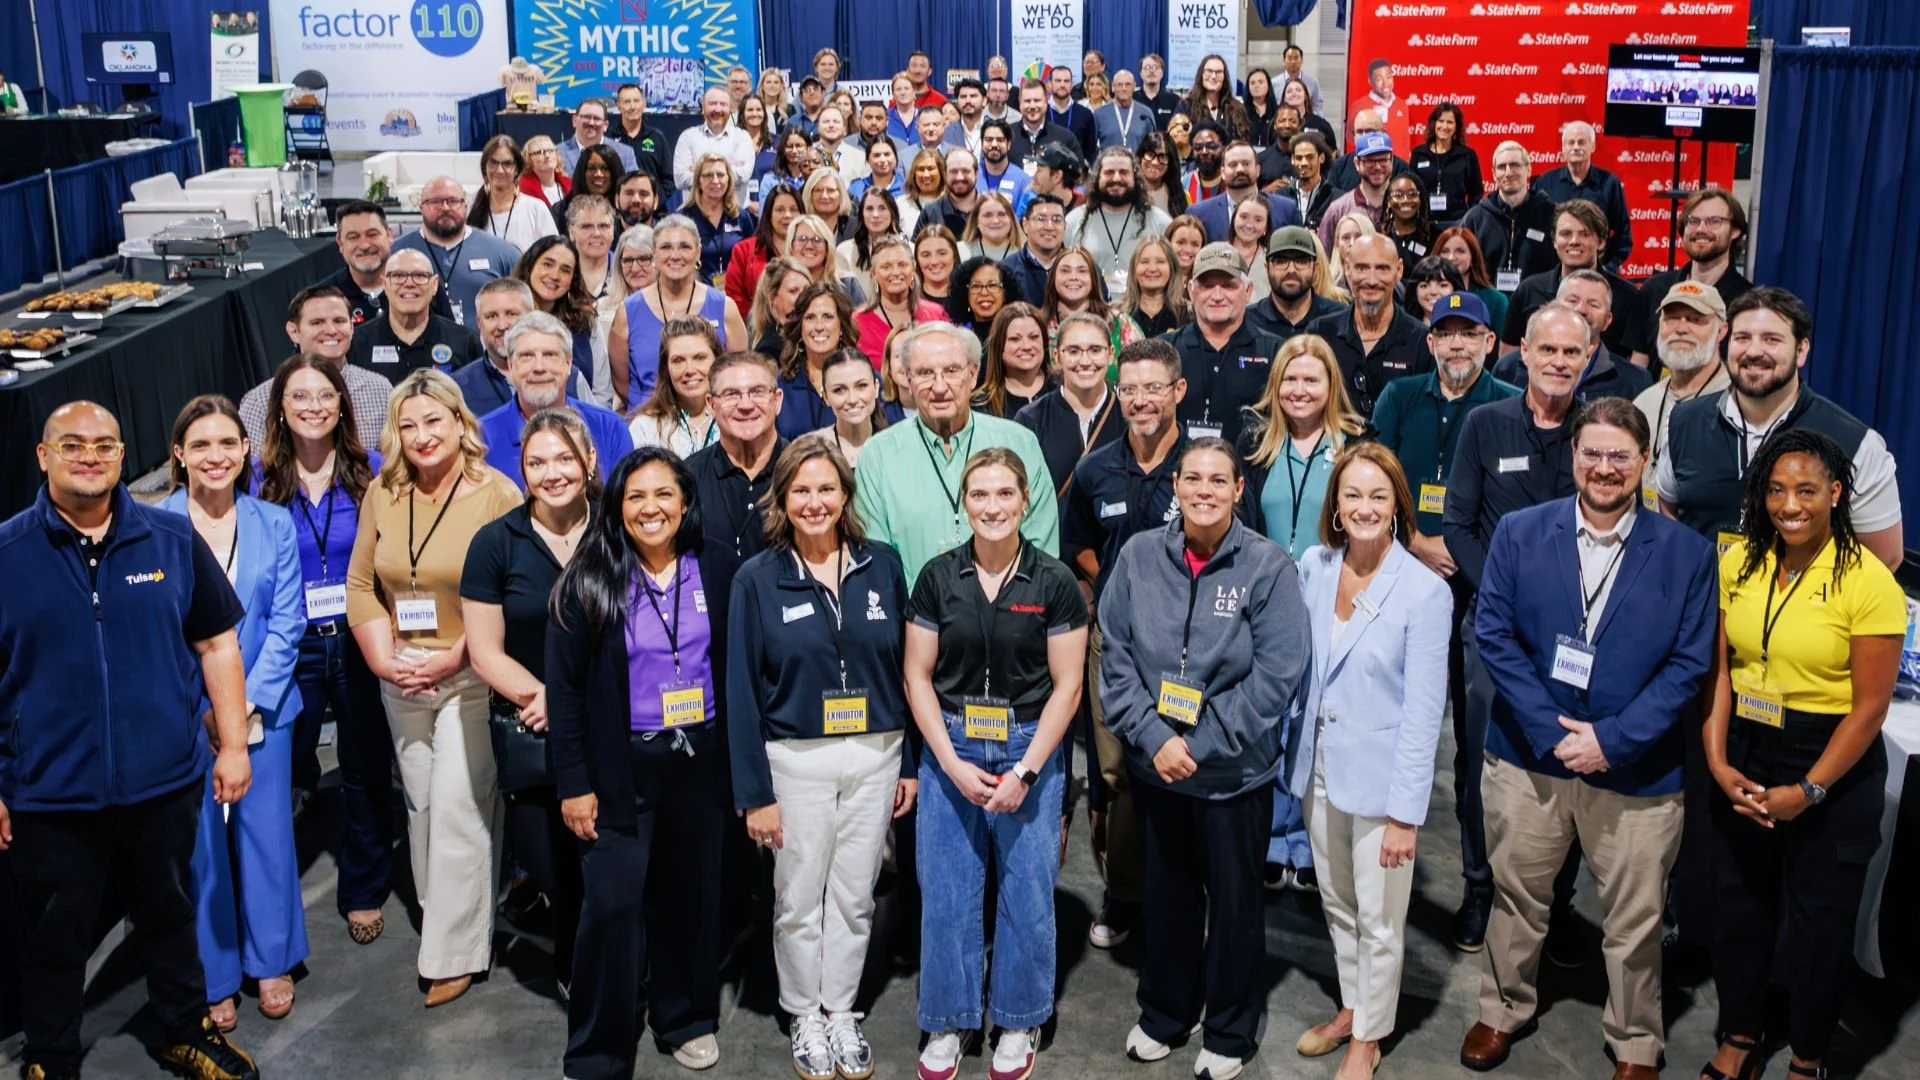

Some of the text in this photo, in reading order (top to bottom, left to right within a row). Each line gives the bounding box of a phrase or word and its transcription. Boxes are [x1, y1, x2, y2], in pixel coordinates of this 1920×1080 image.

[1025, 4, 1071, 17] WHAT
[1181, 4, 1226, 16] WHAT
[299, 3, 480, 39] factor 110
[1022, 16, 1074, 29] WE DO
[1178, 16, 1229, 29] WE DO
[579, 25, 690, 54] MYTHIC
[602, 56, 640, 78] PRE
[1578, 63, 1606, 75] State
[1809, 583, 1827, 602] A
[309, 595, 345, 609] EXHIBITOR
[400, 611, 435, 620] EXHIBITOR
[1556, 658, 1589, 677] EXHIBITOR
[666, 700, 702, 714] EXHIBITOR
[1162, 693, 1198, 712] EXHIBITOR
[1739, 694, 1780, 714] EXHIBITOR
[826, 709, 864, 721] EXHIBITOR
[968, 716, 1006, 729] EXHIBITOR
